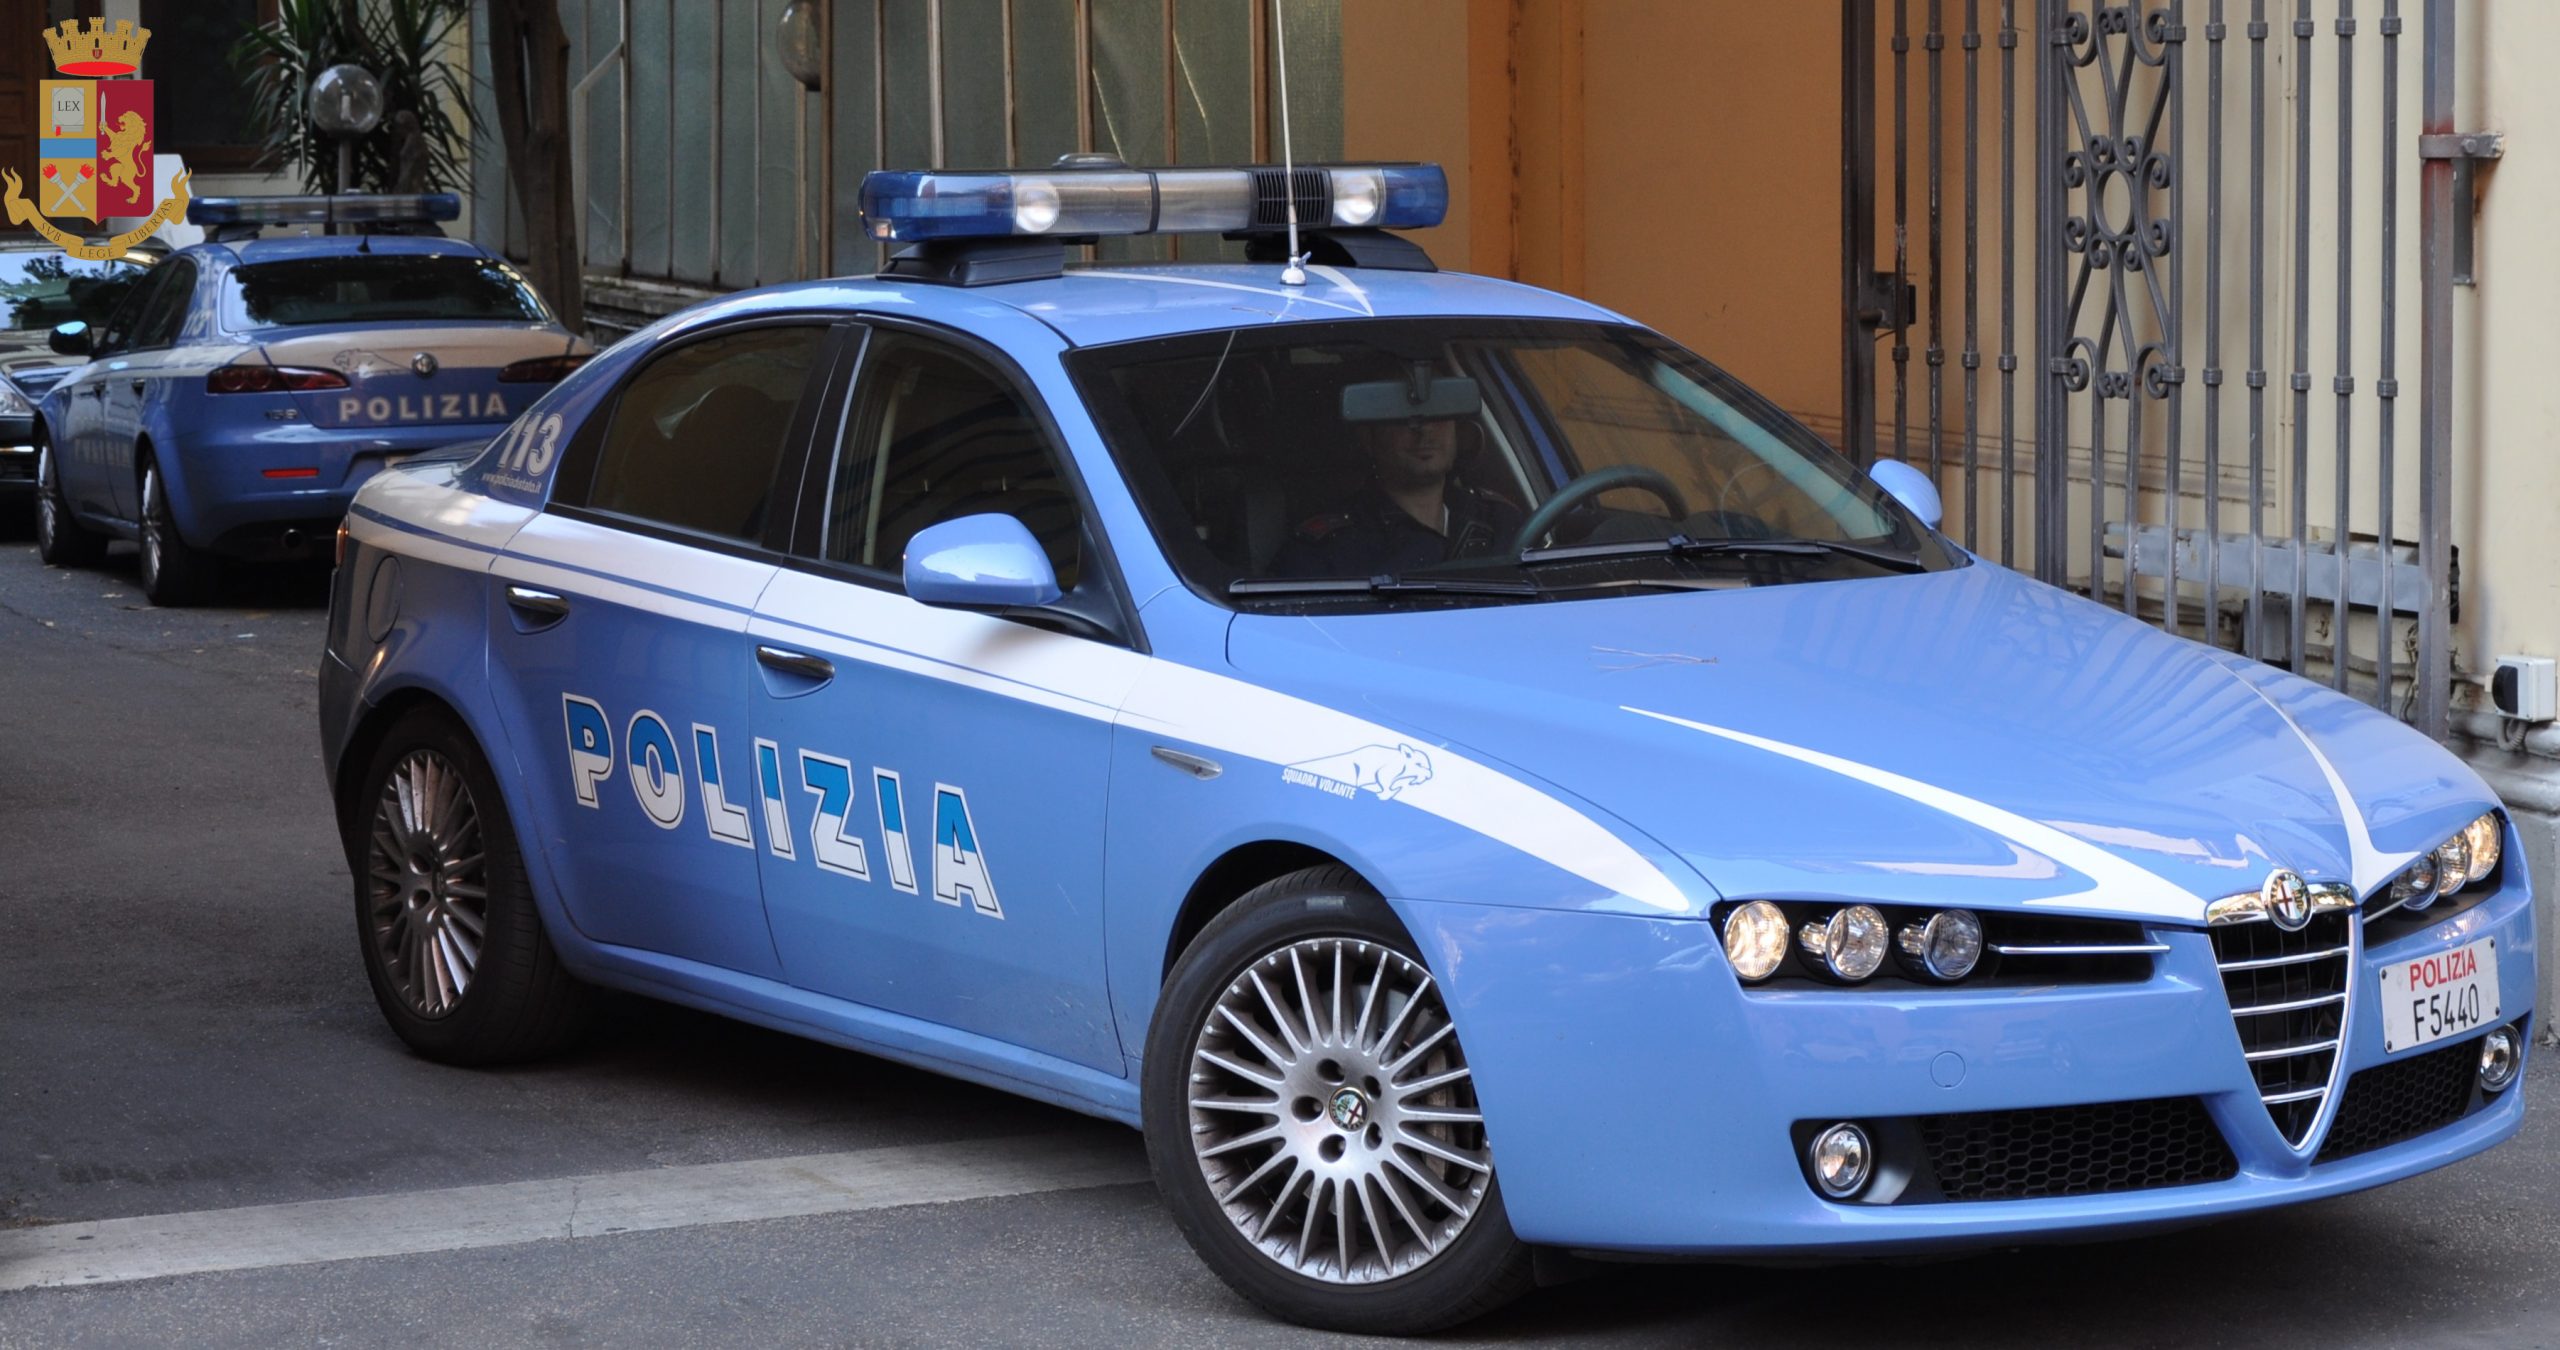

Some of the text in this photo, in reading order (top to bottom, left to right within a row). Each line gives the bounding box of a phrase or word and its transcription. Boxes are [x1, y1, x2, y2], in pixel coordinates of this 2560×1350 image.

[339, 393, 508, 422] POLIZIA
[497, 411, 563, 477] 113
[562, 692, 1005, 920] POLIZIA
[1281, 767, 1358, 800] SQUADRA VOLANTE
[2409, 948, 2477, 992] POLIZIA
[2413, 983, 2480, 1042] F5440
